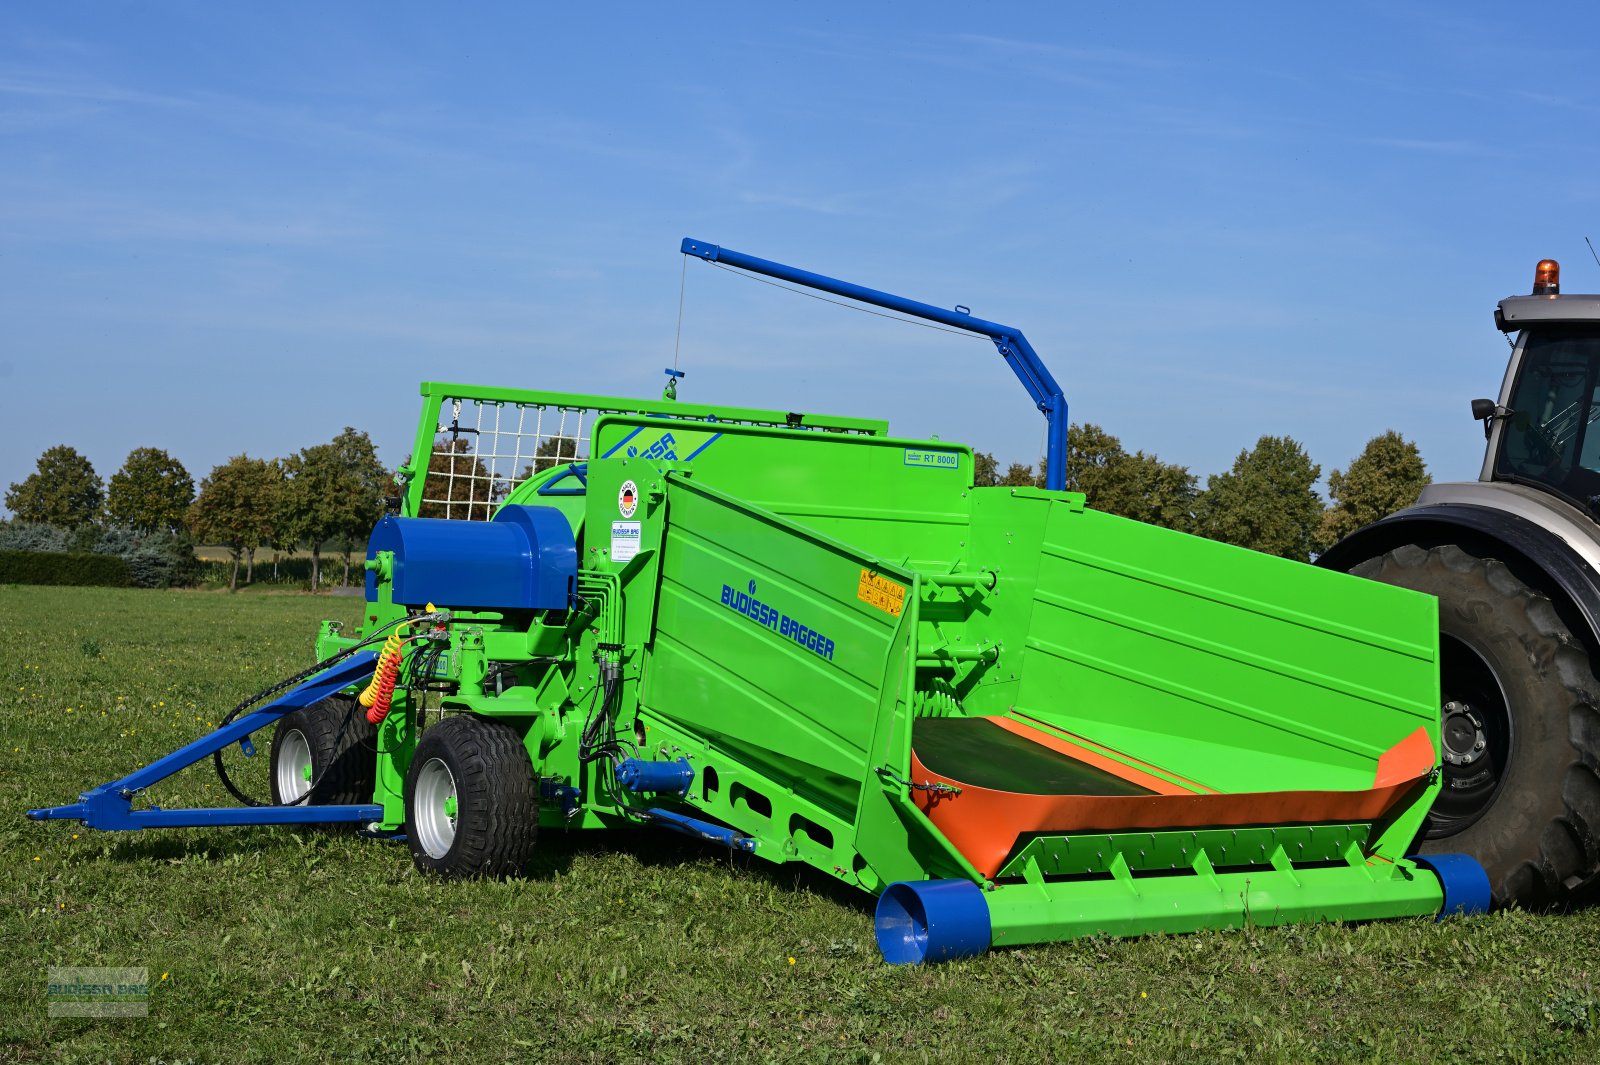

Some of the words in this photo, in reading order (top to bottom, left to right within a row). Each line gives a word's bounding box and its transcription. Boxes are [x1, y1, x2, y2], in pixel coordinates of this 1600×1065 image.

[924, 454, 935, 463] RT
[937, 455, 956, 465] 8000
[720, 581, 779, 631] BUDISSA
[779, 613, 836, 662] BAGGER
